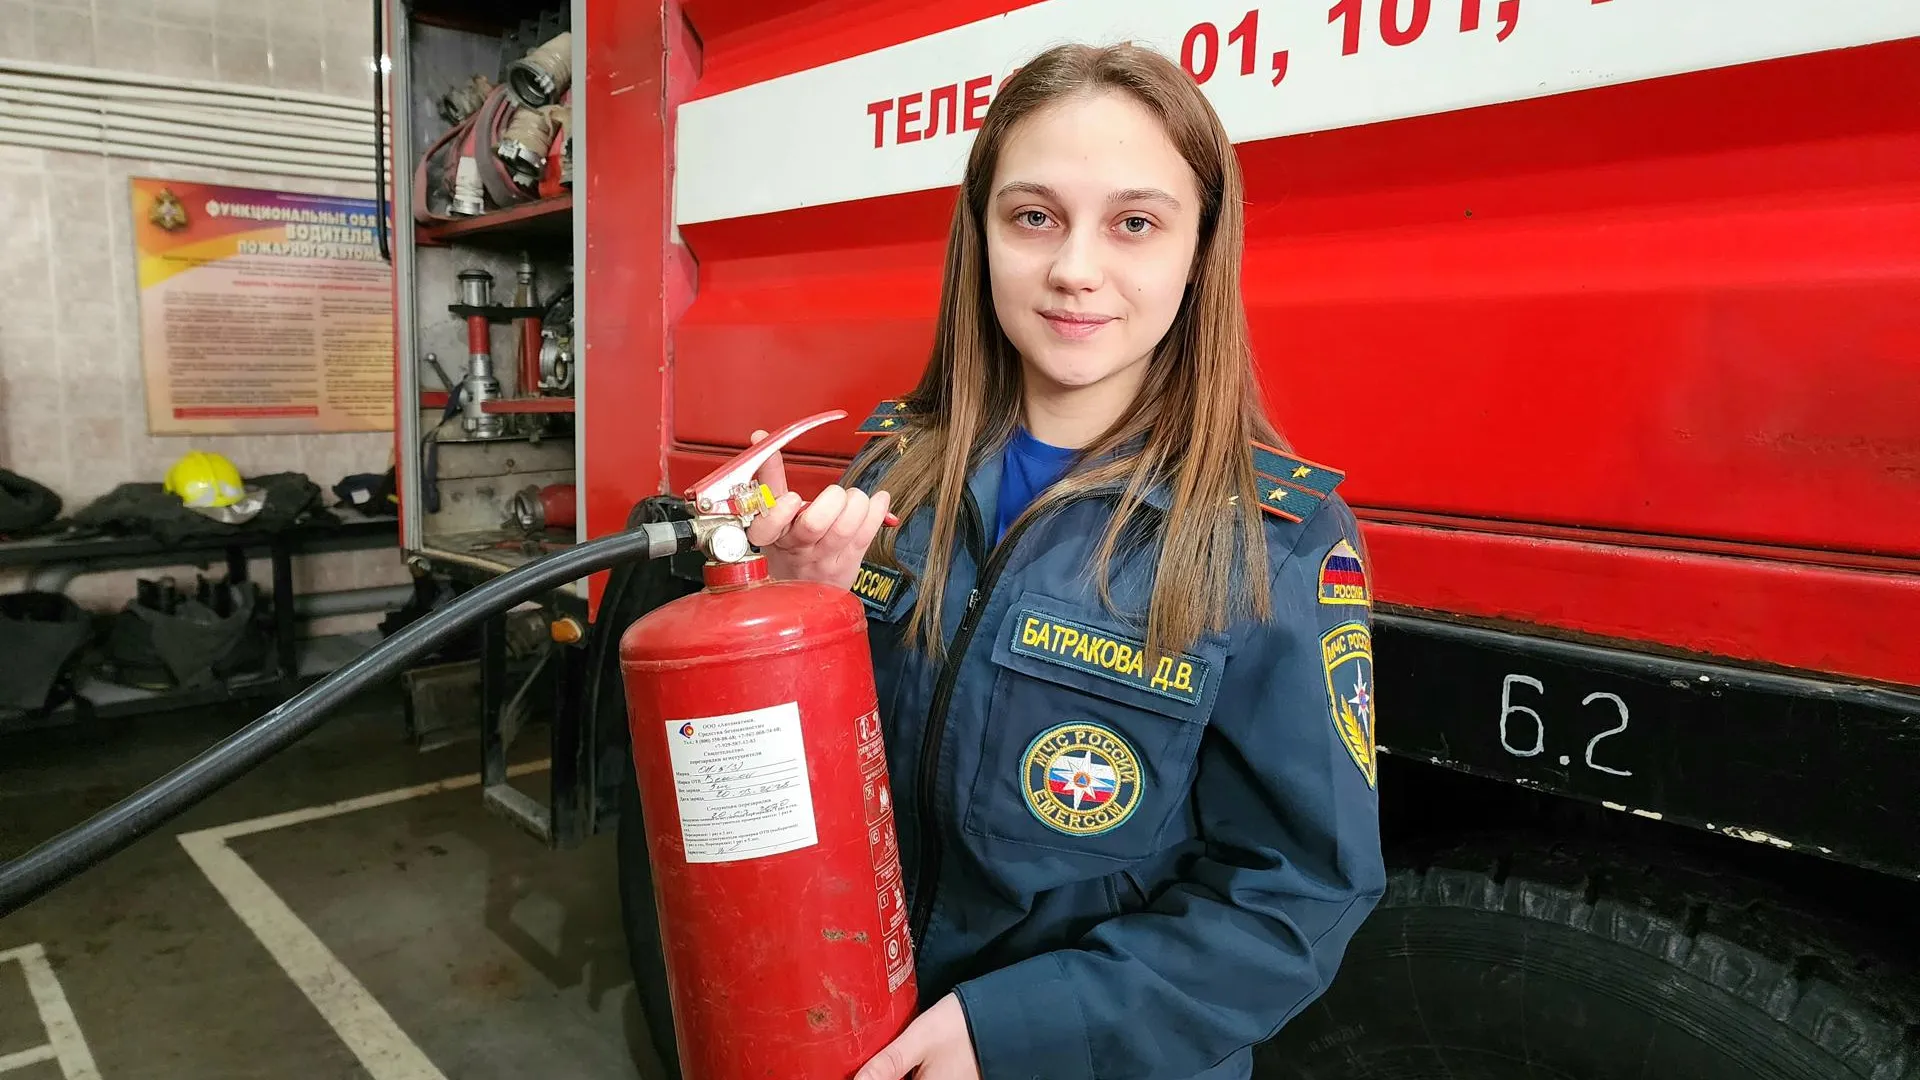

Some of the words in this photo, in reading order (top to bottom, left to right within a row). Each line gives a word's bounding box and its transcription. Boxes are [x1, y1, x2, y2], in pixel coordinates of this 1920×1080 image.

[867, 68, 1020, 149] ТЕЛЕ
[1180, 9, 1289, 88] 01,
[205, 199, 347, 225] ФУНКЦИОНАЛЬНЫЕ
[238, 240, 326, 258] ПОЖАРНОГО
[331, 246, 384, 262] АВТОМО
[286, 223, 372, 244] ВОДИТЕЛЯ
[853, 567, 895, 603] ОССИИ
[1333, 584, 1363, 599] РОССИЯ
[1022, 617, 1143, 678] БАТРАКОВА
[1150, 655, 1193, 693] Д.В.
[1327, 635, 1347, 662] МЧС
[1347, 632, 1371, 651] РОСС
[1500, 674, 1633, 776] 6.2
[1034, 734, 1069, 768] МЧС
[1074, 731, 1136, 783] РОССИИ
[1033, 789, 1125, 829] EMERCOM
